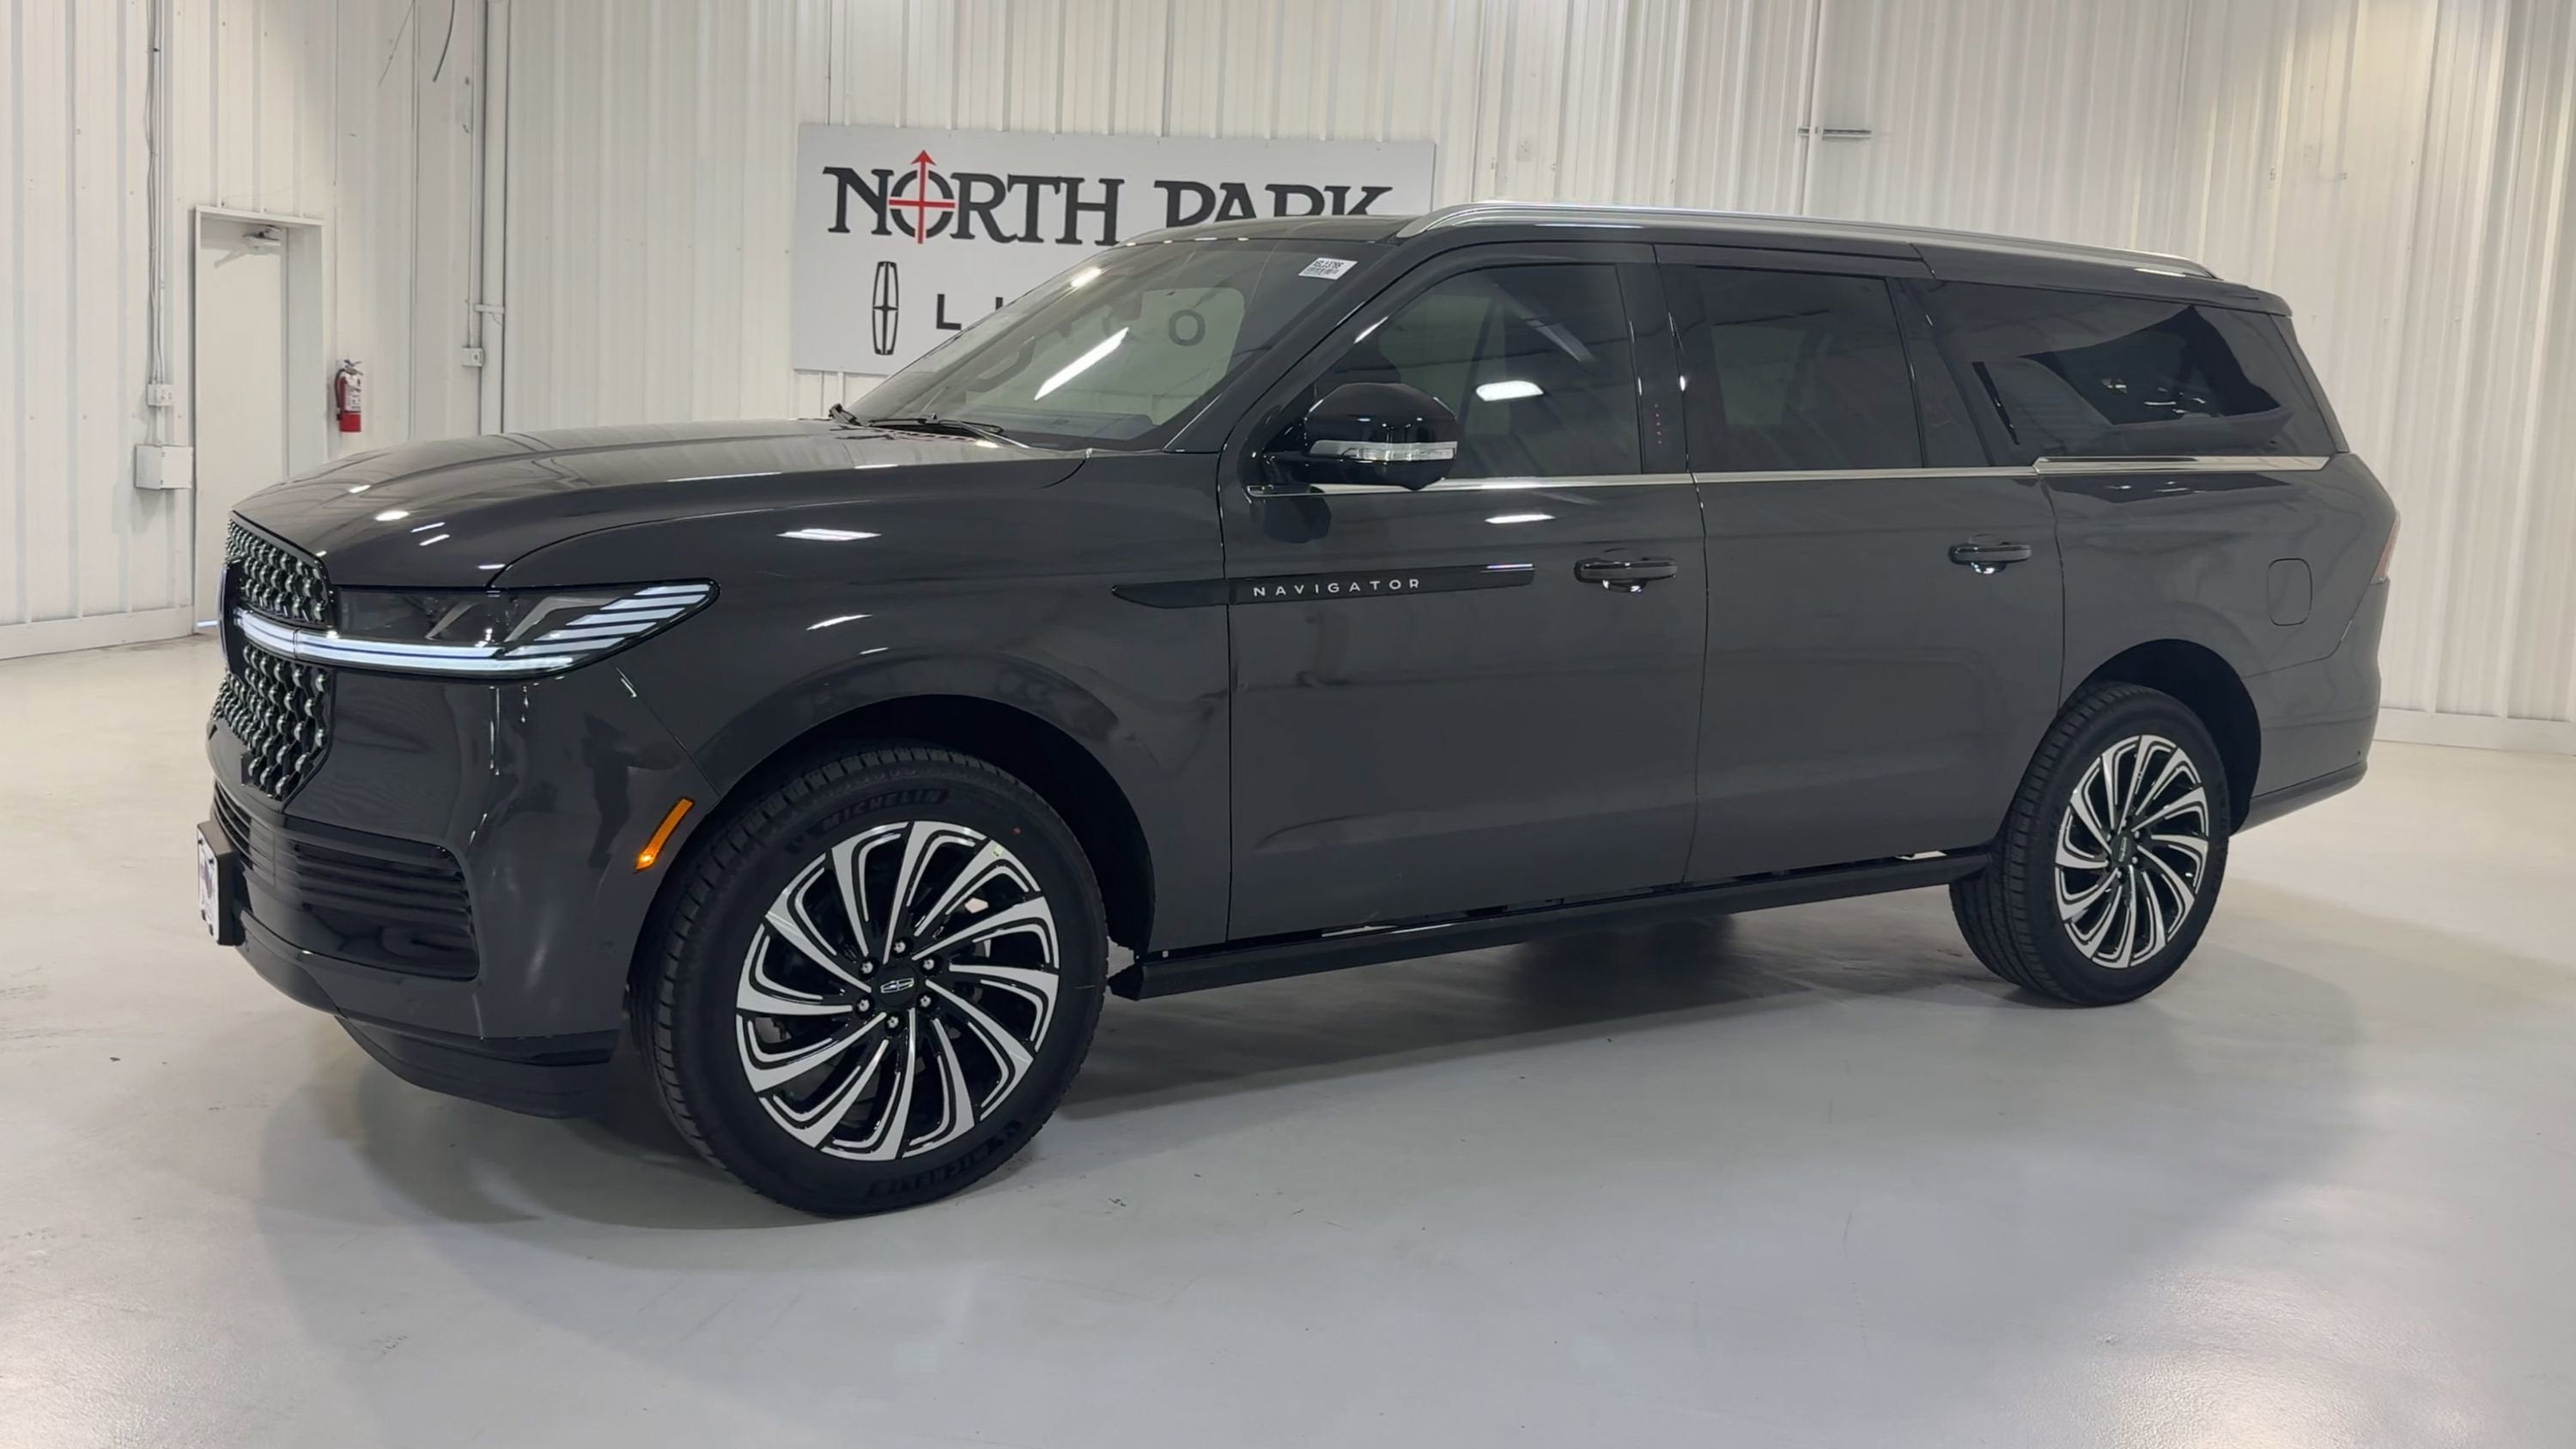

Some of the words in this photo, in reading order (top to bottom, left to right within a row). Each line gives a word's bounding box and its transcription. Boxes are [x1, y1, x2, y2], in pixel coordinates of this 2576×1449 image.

[823, 167, 1125, 246] NORTH
[1254, 579, 1419, 597] NAVIGATOR
[822, 789, 946, 832] MICHELIN
